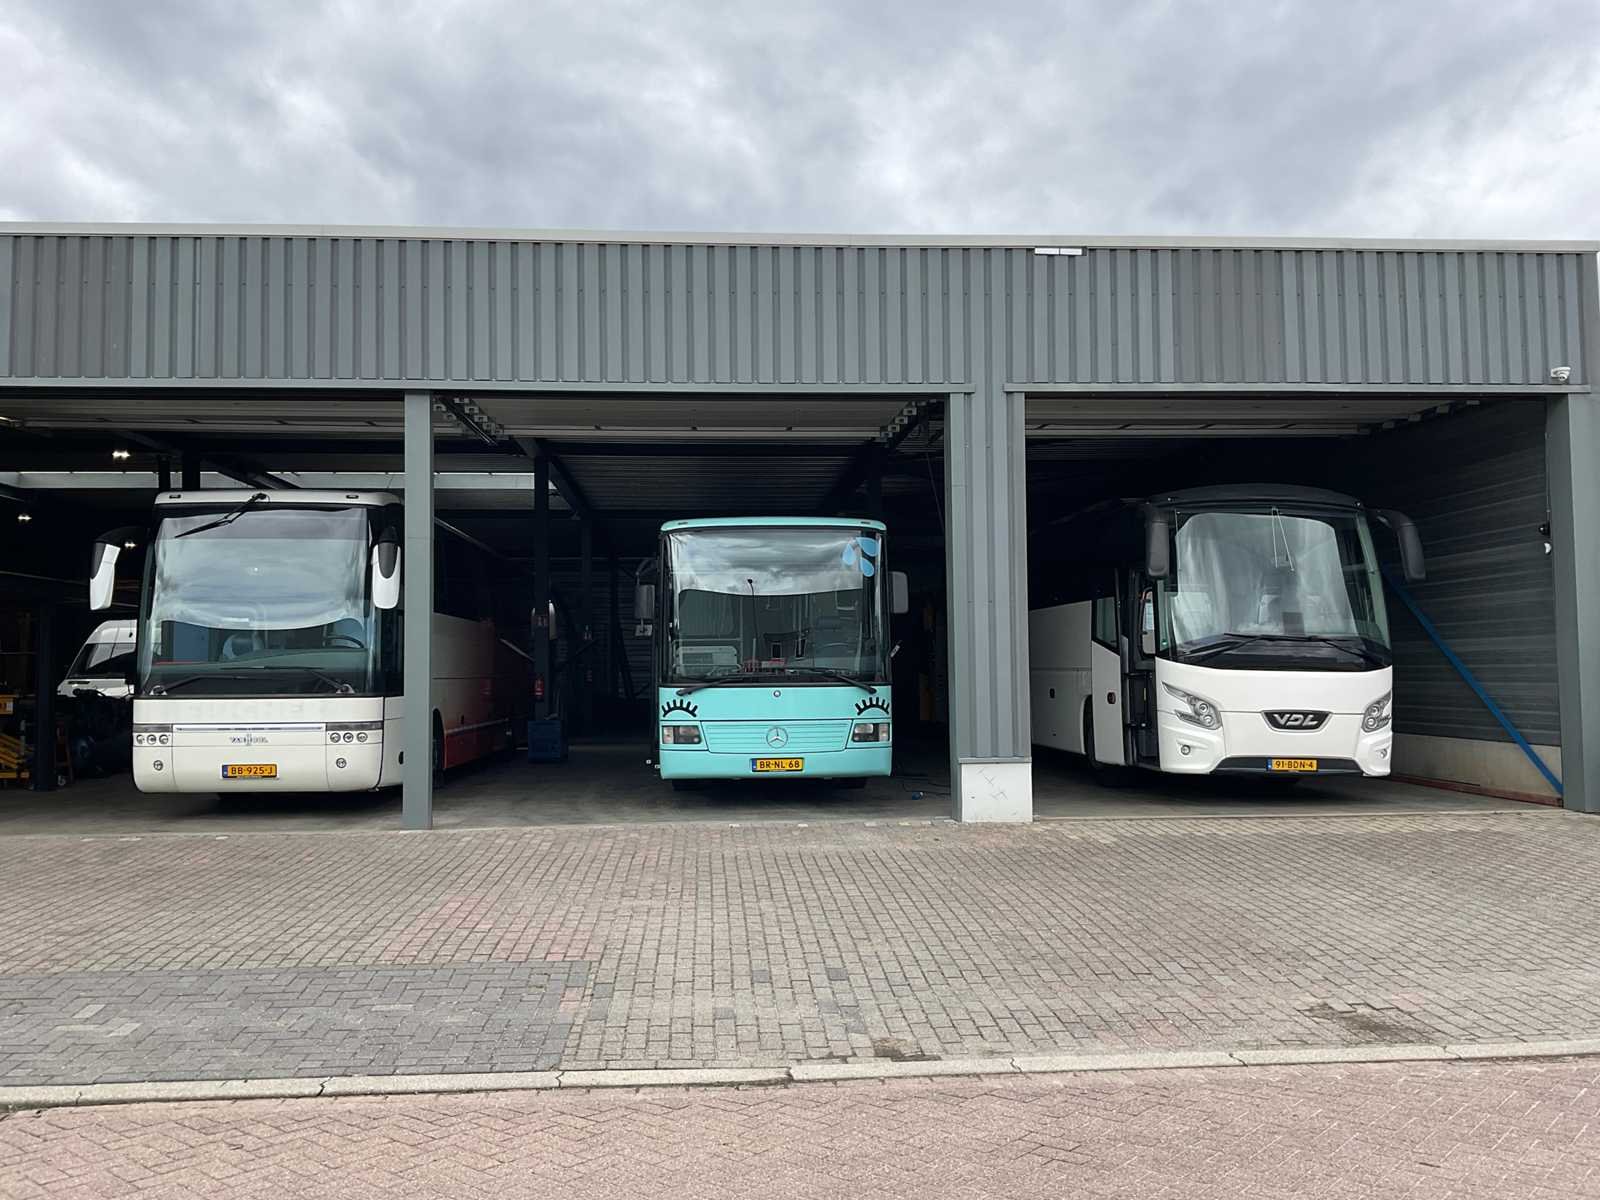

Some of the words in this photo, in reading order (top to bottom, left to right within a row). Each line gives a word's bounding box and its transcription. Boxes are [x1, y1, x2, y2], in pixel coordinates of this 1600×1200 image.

[1272, 713, 1319, 726] VDL
[1275, 760, 1313, 769] 91-BDN-4
[231, 766, 273, 775] BB-925-J
